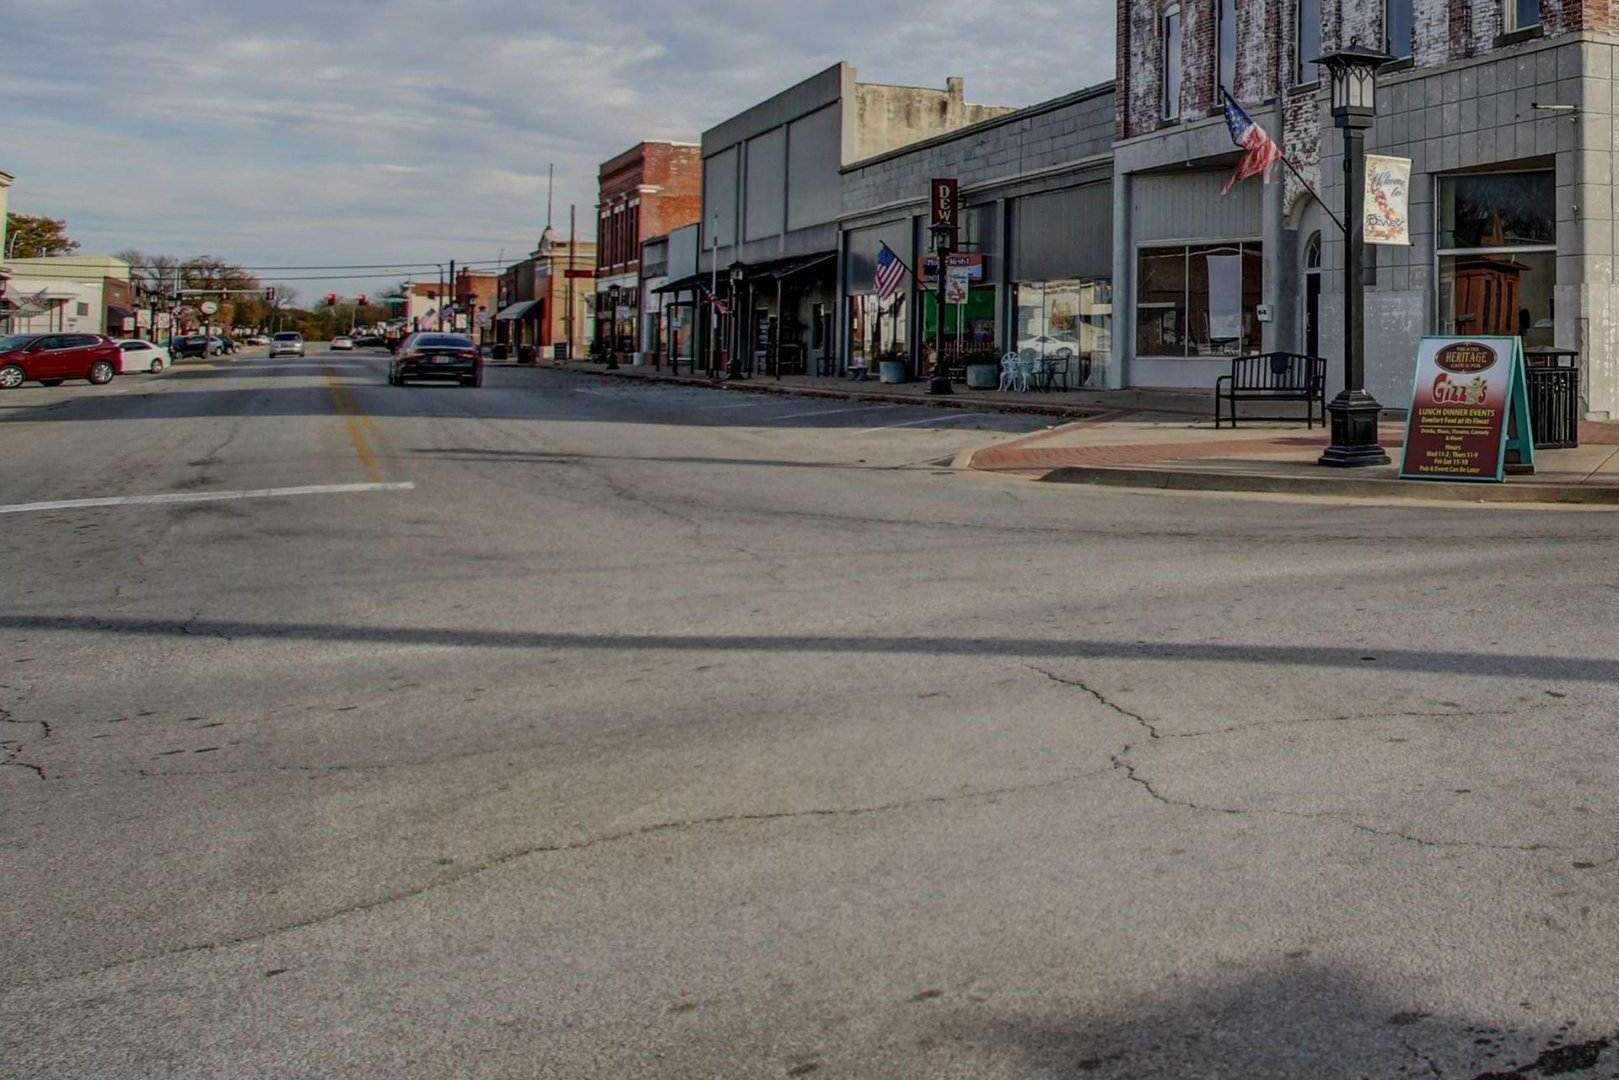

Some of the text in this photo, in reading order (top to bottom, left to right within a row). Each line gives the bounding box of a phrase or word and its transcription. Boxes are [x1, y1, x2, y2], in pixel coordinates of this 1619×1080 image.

[1446, 351, 1487, 363] HERITAGE
[1418, 408, 1496, 417] LUNCH DINNER EVENTS
